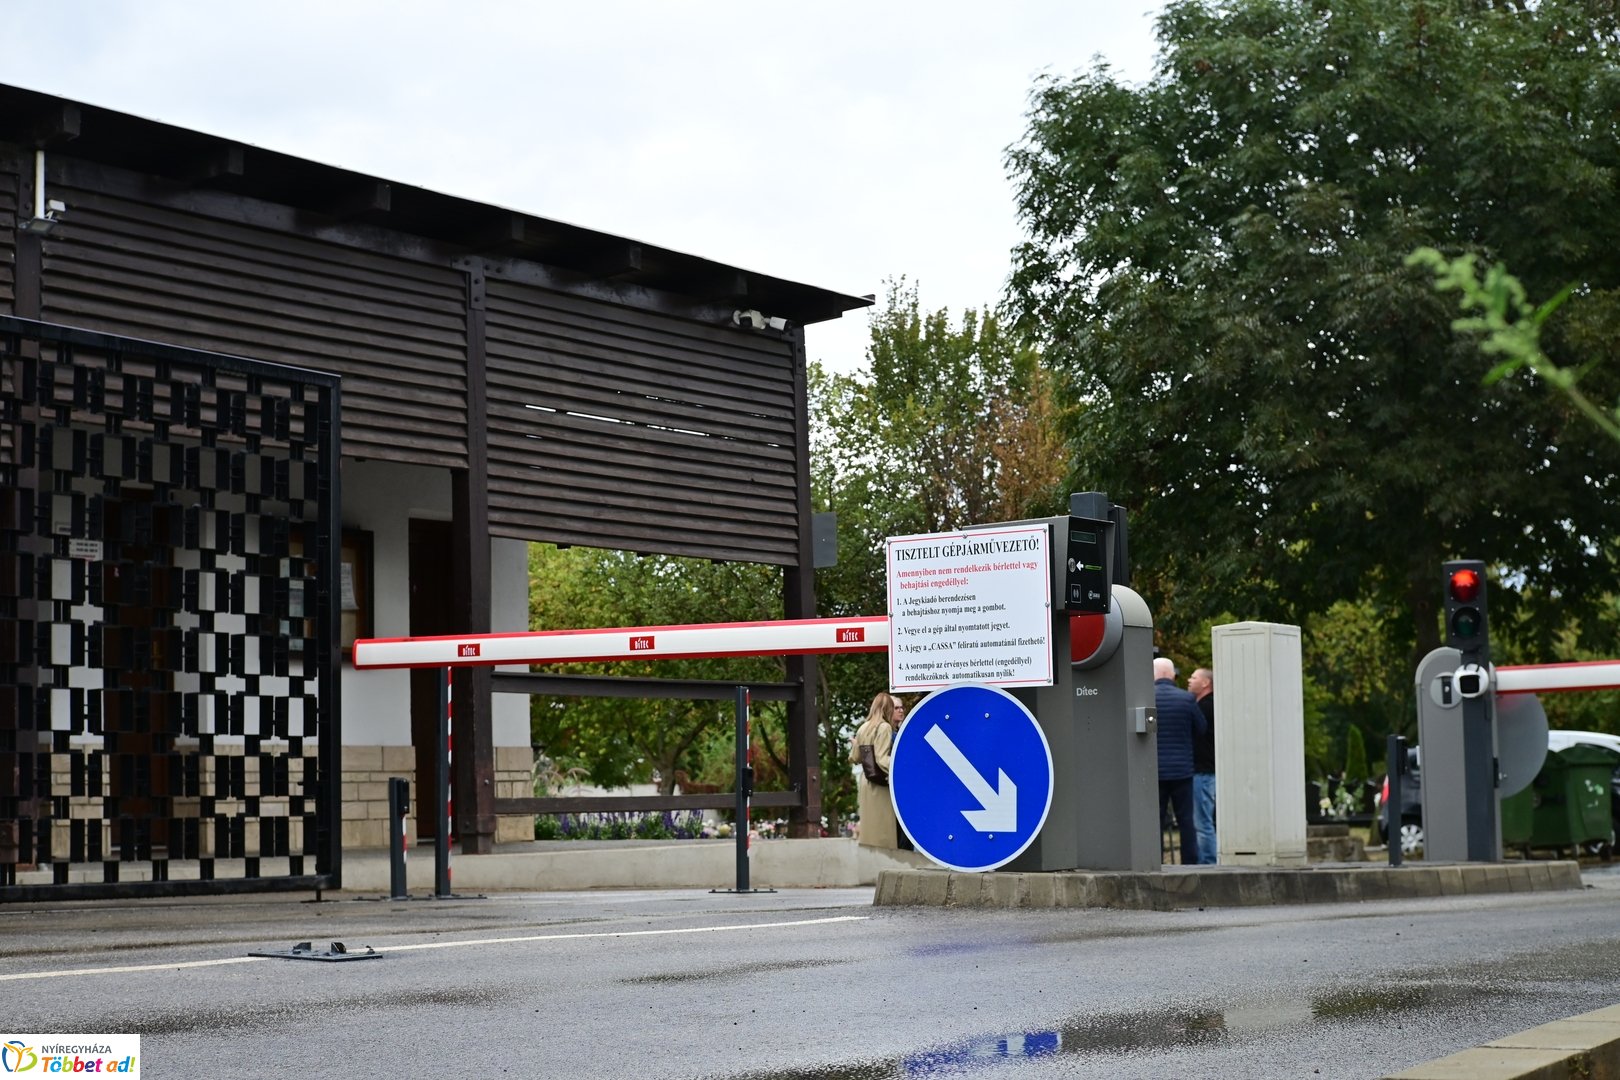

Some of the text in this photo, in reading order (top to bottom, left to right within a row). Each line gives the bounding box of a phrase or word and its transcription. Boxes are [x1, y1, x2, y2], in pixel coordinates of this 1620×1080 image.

[895, 535, 1039, 561] TISZTELT GÉPJÁRMŰVEZETŐ!
[896, 567, 937, 578] Amennyiben
[953, 563, 992, 574] rendelkezik
[993, 561, 1021, 571] bérlettel
[1022, 562, 1038, 571] vagy
[900, 577, 969, 590] behajtási engedéllyel:
[896, 598, 902, 606] 1.
[908, 595, 938, 606] Jegykiadó
[938, 593, 976, 603] berendezésen
[906, 607, 940, 617] behajtáshoz
[941, 605, 963, 616] nyomja
[964, 606, 977, 614] meg
[982, 603, 1006, 613] gombot.
[897, 627, 903, 635] 2.
[904, 627, 921, 636] Vegye
[921, 626, 927, 634] el
[932, 625, 943, 635] gép
[944, 624, 957, 632] által
[958, 623, 990, 633] nyomtatott
[990, 621, 1010, 632] jegyet.
[897, 644, 904, 652] 3.
[905, 644, 910, 652] A
[910, 644, 922, 653] jegy
[980, 637, 1017, 647] automatánál
[1017, 636, 1046, 646] fizethető!
[898, 662, 904, 670] 4.
[910, 661, 935, 671] sorompó
[943, 660, 969, 670] érvényes
[969, 658, 994, 667] bérlettel
[995, 656, 1032, 667] (engedéllyel)
[905, 672, 950, 682] rendelkezőknek
[951, 671, 995, 679] automatikusan
